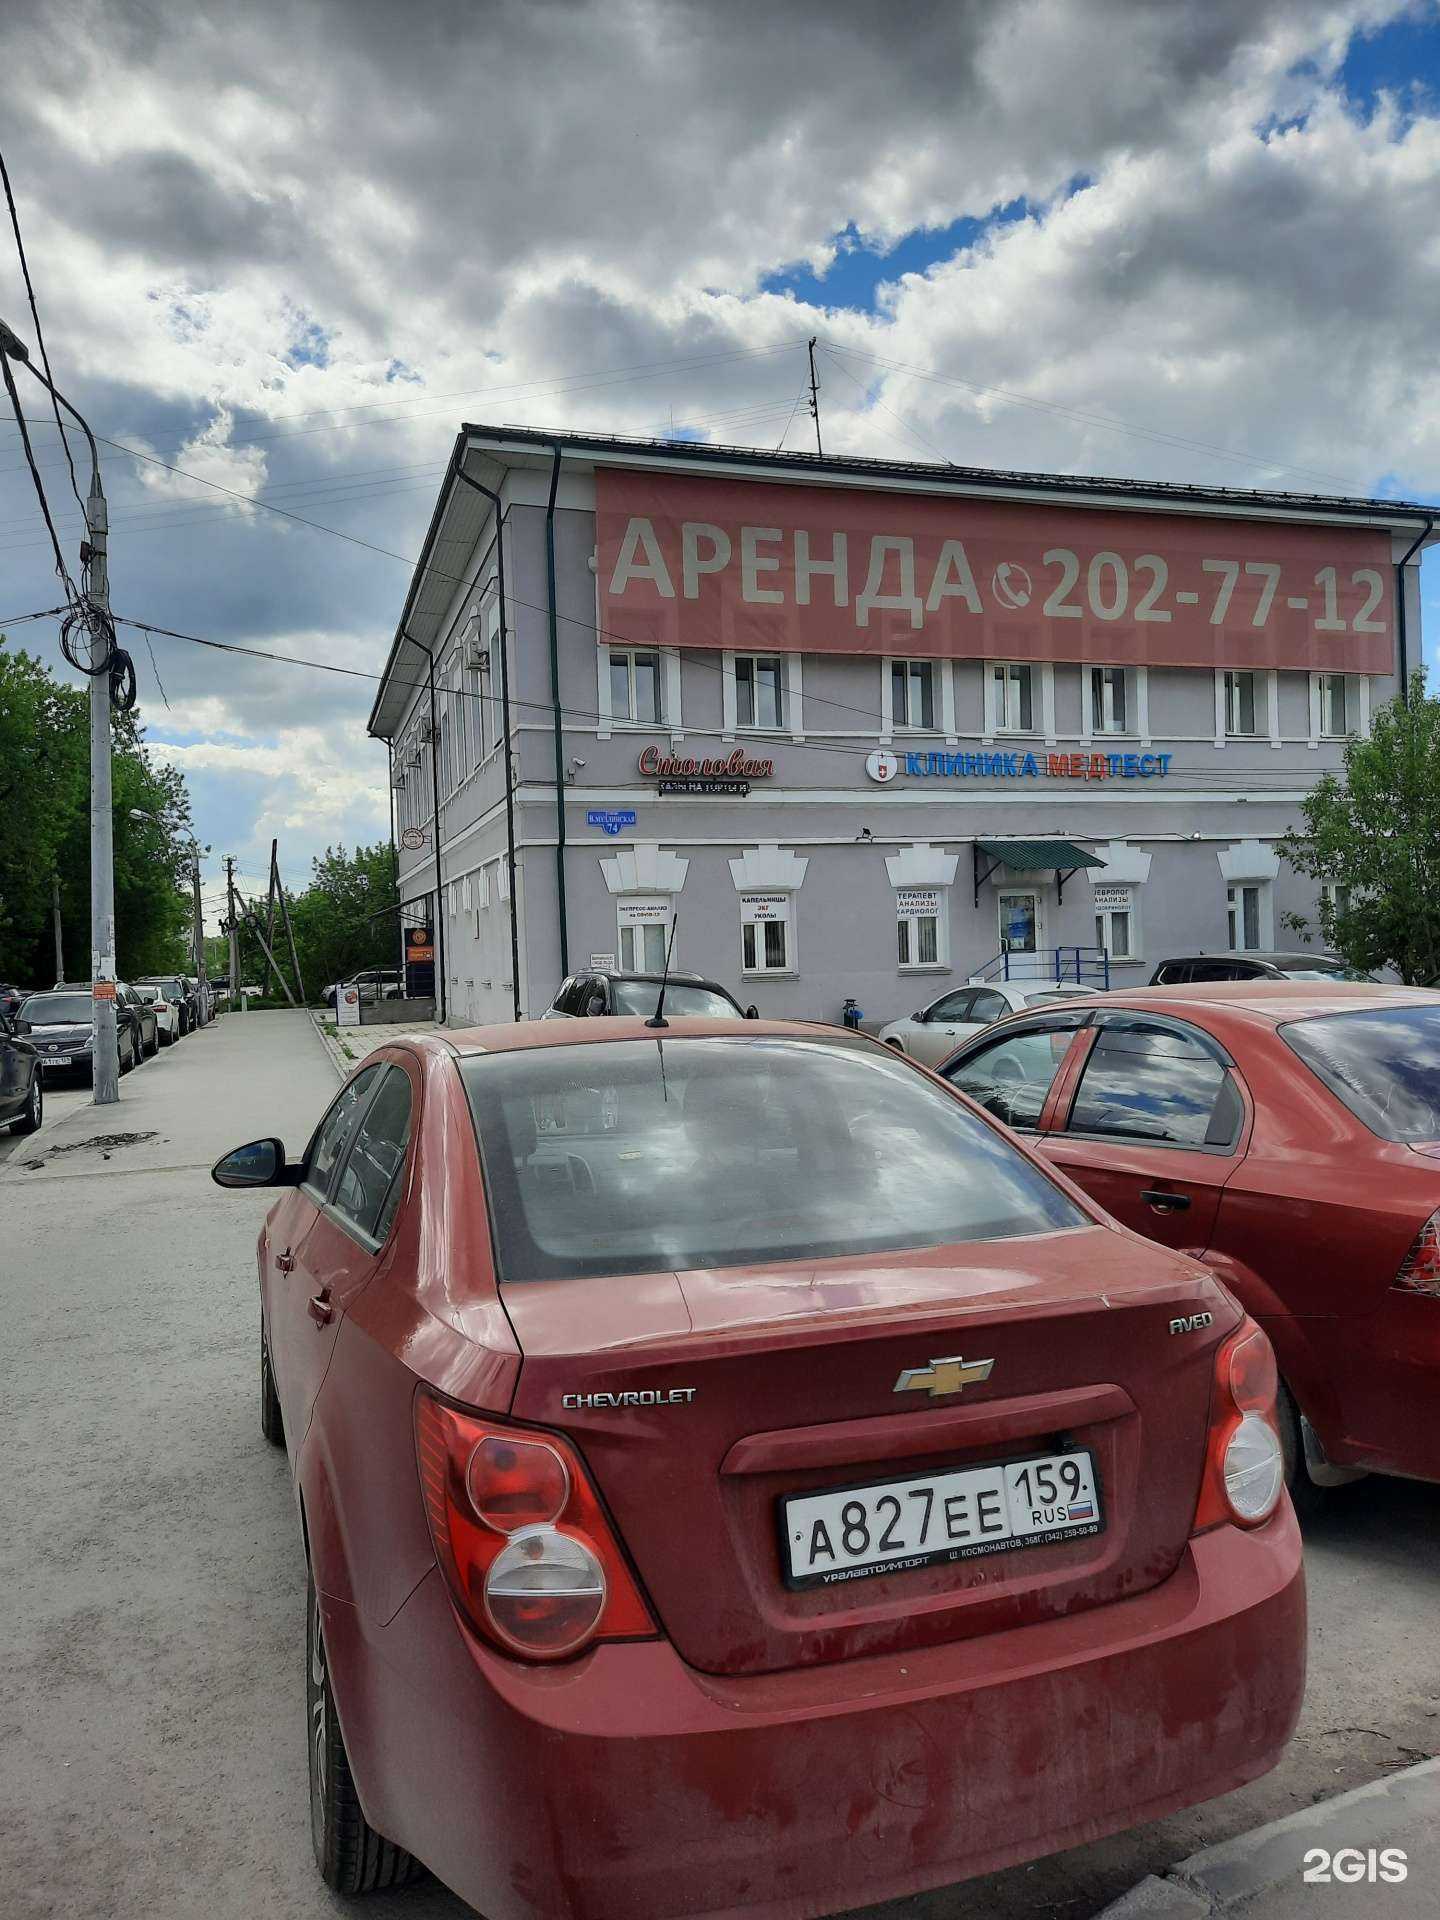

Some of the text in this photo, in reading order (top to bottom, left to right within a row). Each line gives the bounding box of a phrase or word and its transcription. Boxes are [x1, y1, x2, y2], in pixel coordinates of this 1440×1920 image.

[608, 516, 1387, 633] АРЕНДА 202-77-12
[638, 743, 776, 777] Столовая
[905, 751, 1172, 781] КЛИНИКА МЕДТЕСТ
[607, 823, 618, 833] 74
[1169, 1311, 1214, 1335] AVEO
[562, 1388, 697, 1409] CHEVROLET
[809, 1460, 1081, 1565] А827ЕЕ 159
[1032, 1507, 1067, 1526] RUS
